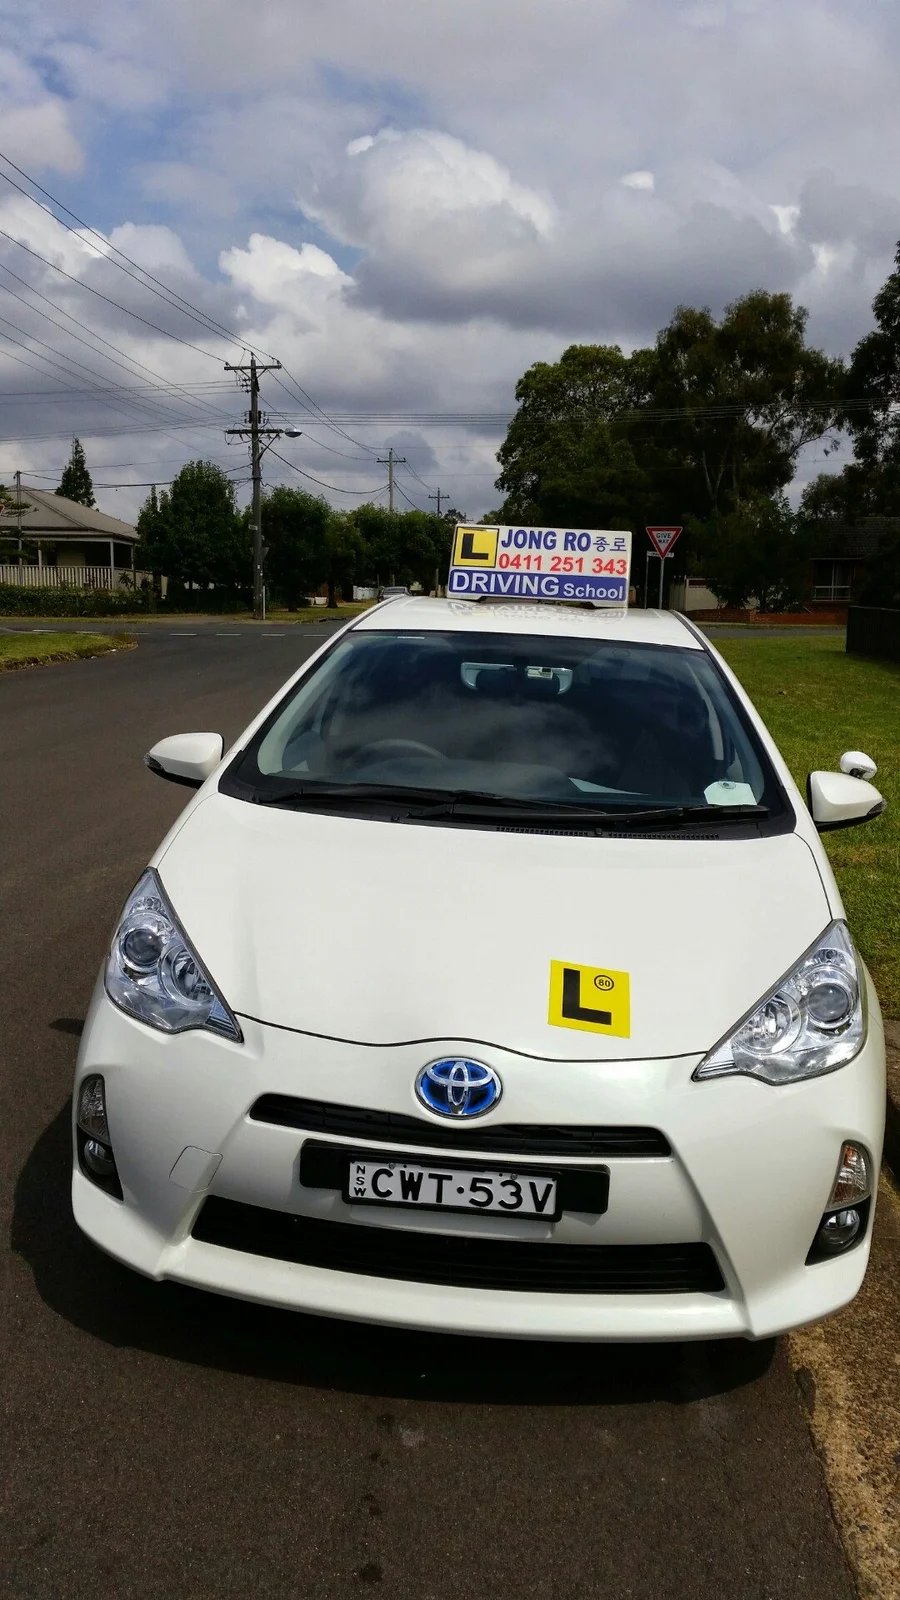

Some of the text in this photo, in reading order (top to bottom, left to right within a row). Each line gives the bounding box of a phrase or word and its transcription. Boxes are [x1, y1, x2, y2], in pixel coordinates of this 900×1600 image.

[461, 533, 489, 560] L
[501, 529, 627, 553] JONG RO 종로
[498, 553, 627, 575] 0411 251 343
[452, 571, 624, 599] DRIVING School
[598, 979, 611, 987] 80
[562, 968, 612, 1026] L
